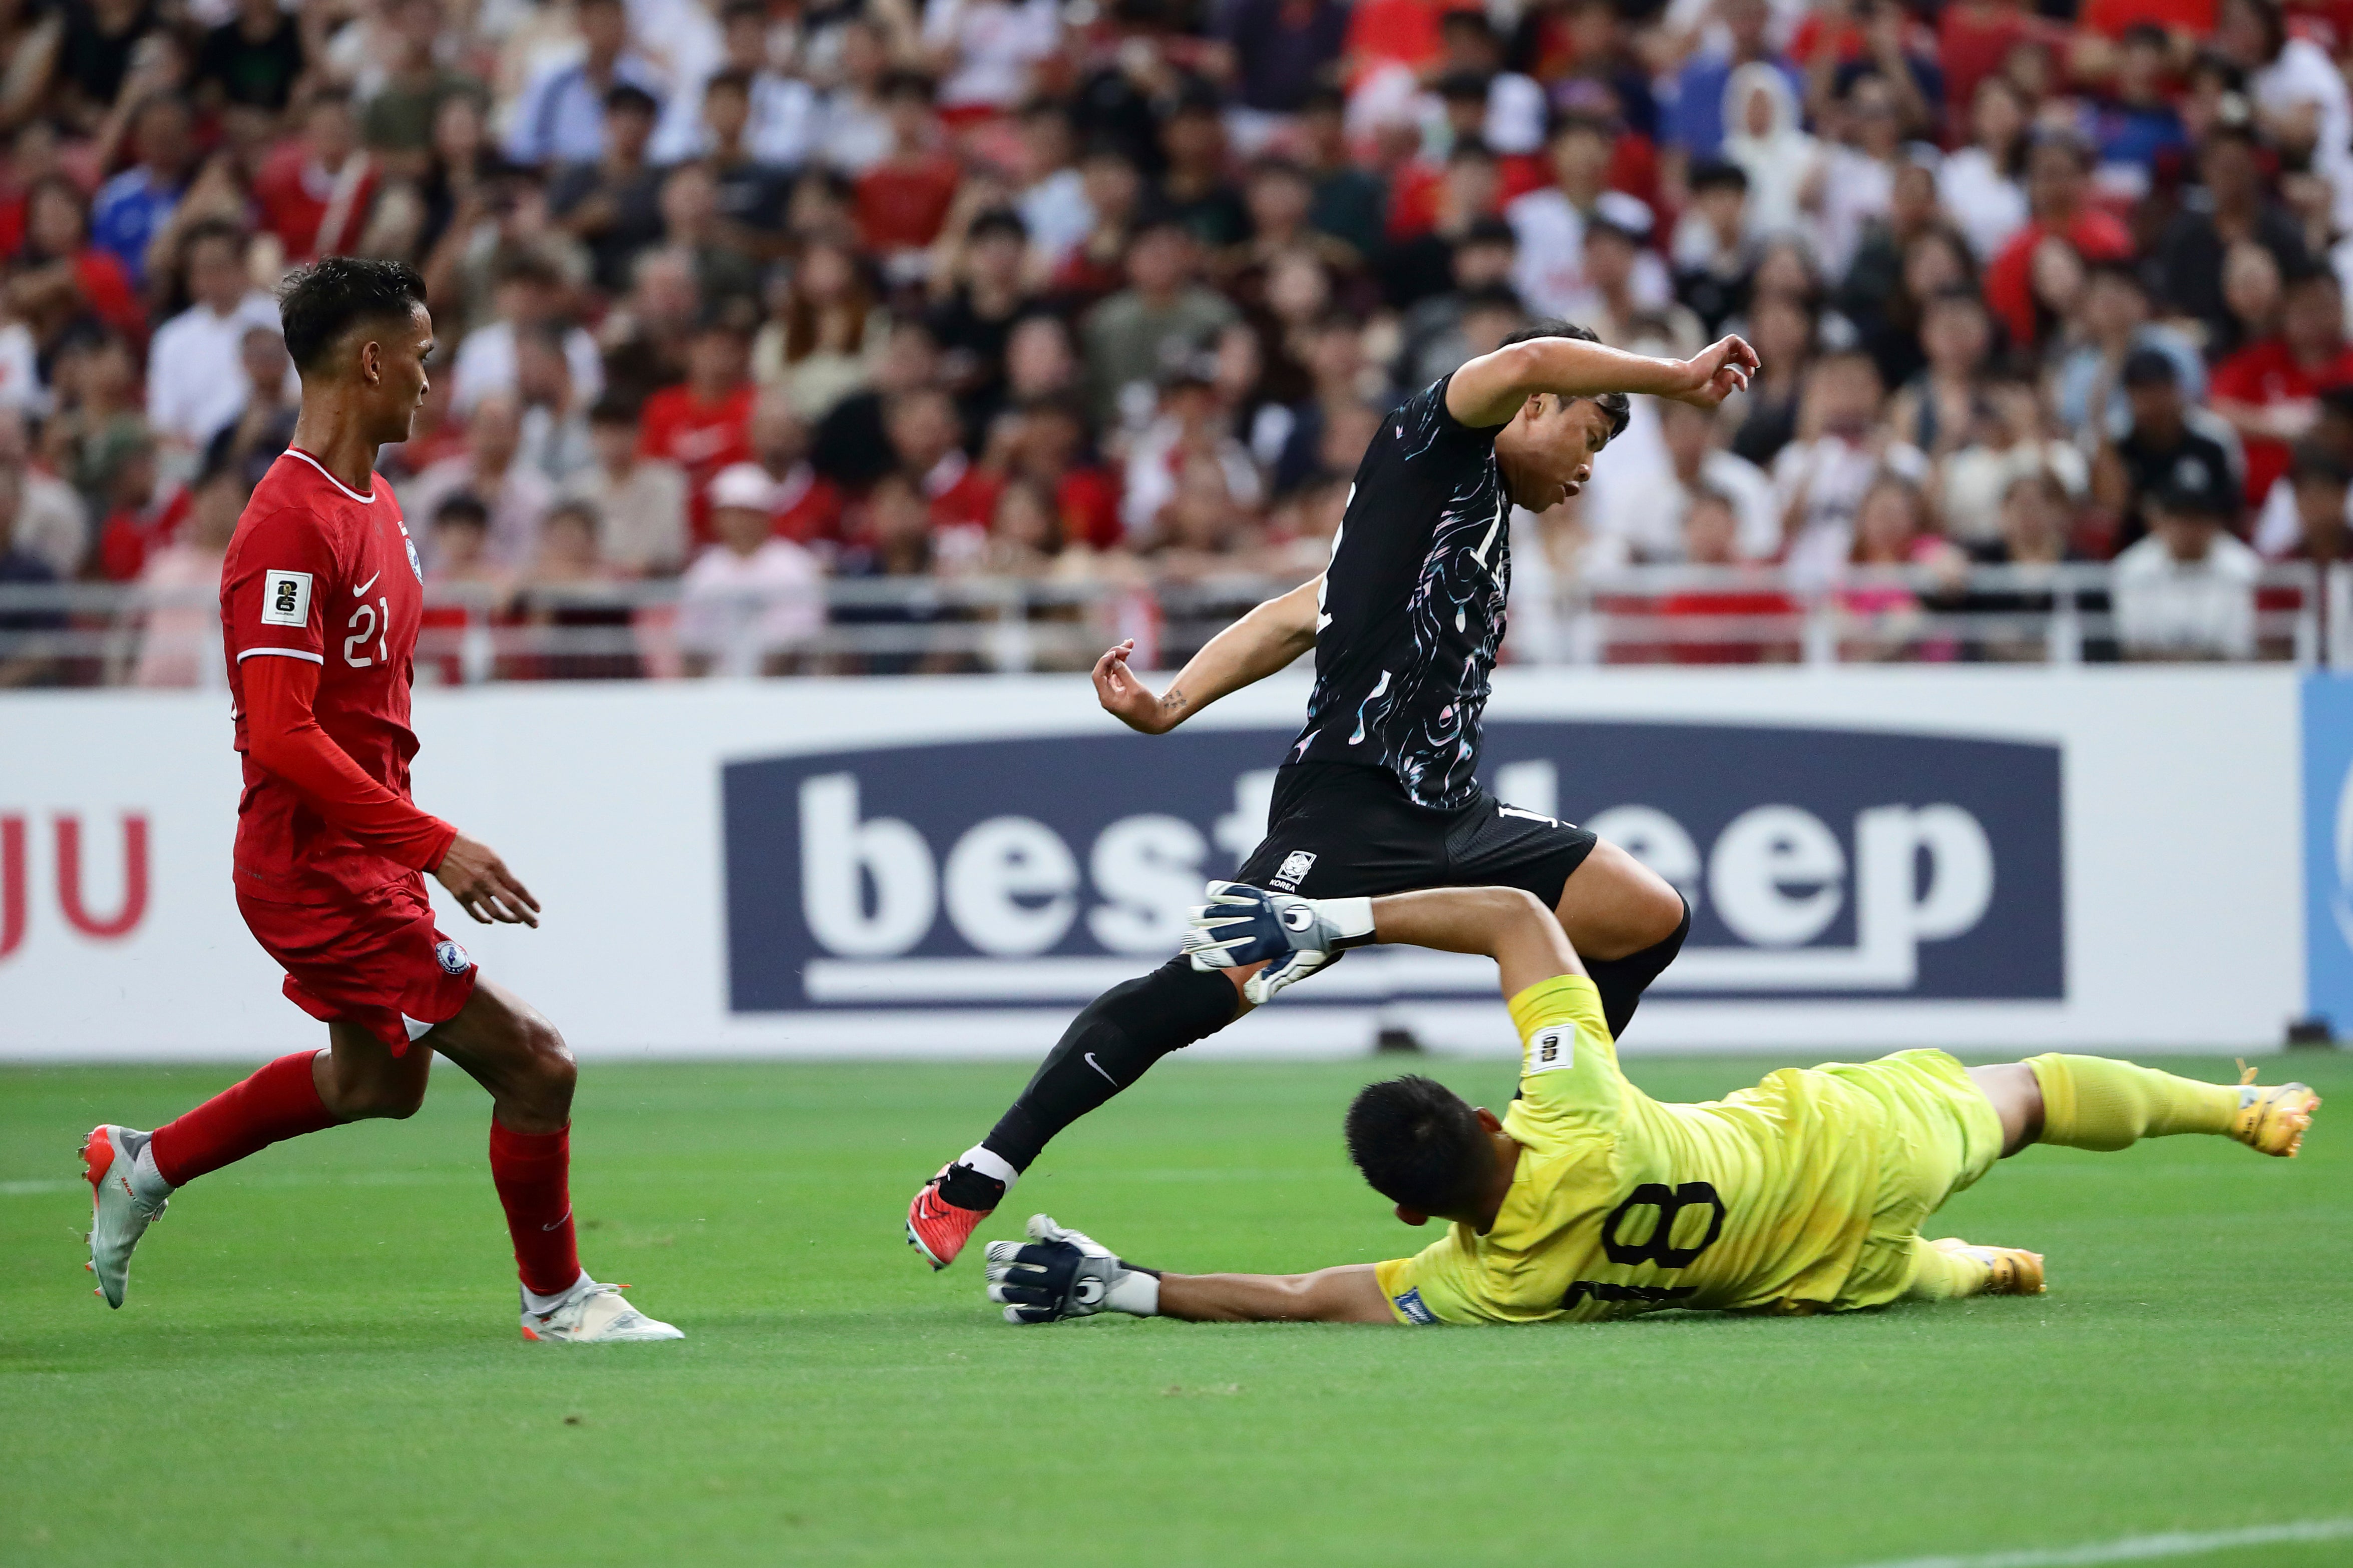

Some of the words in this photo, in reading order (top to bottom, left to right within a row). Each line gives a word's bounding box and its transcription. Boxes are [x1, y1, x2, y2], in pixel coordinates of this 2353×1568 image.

[344, 597, 388, 668] 21
[1269, 879, 1296, 893] KOREA
[1556, 1181, 1726, 1310] 18
